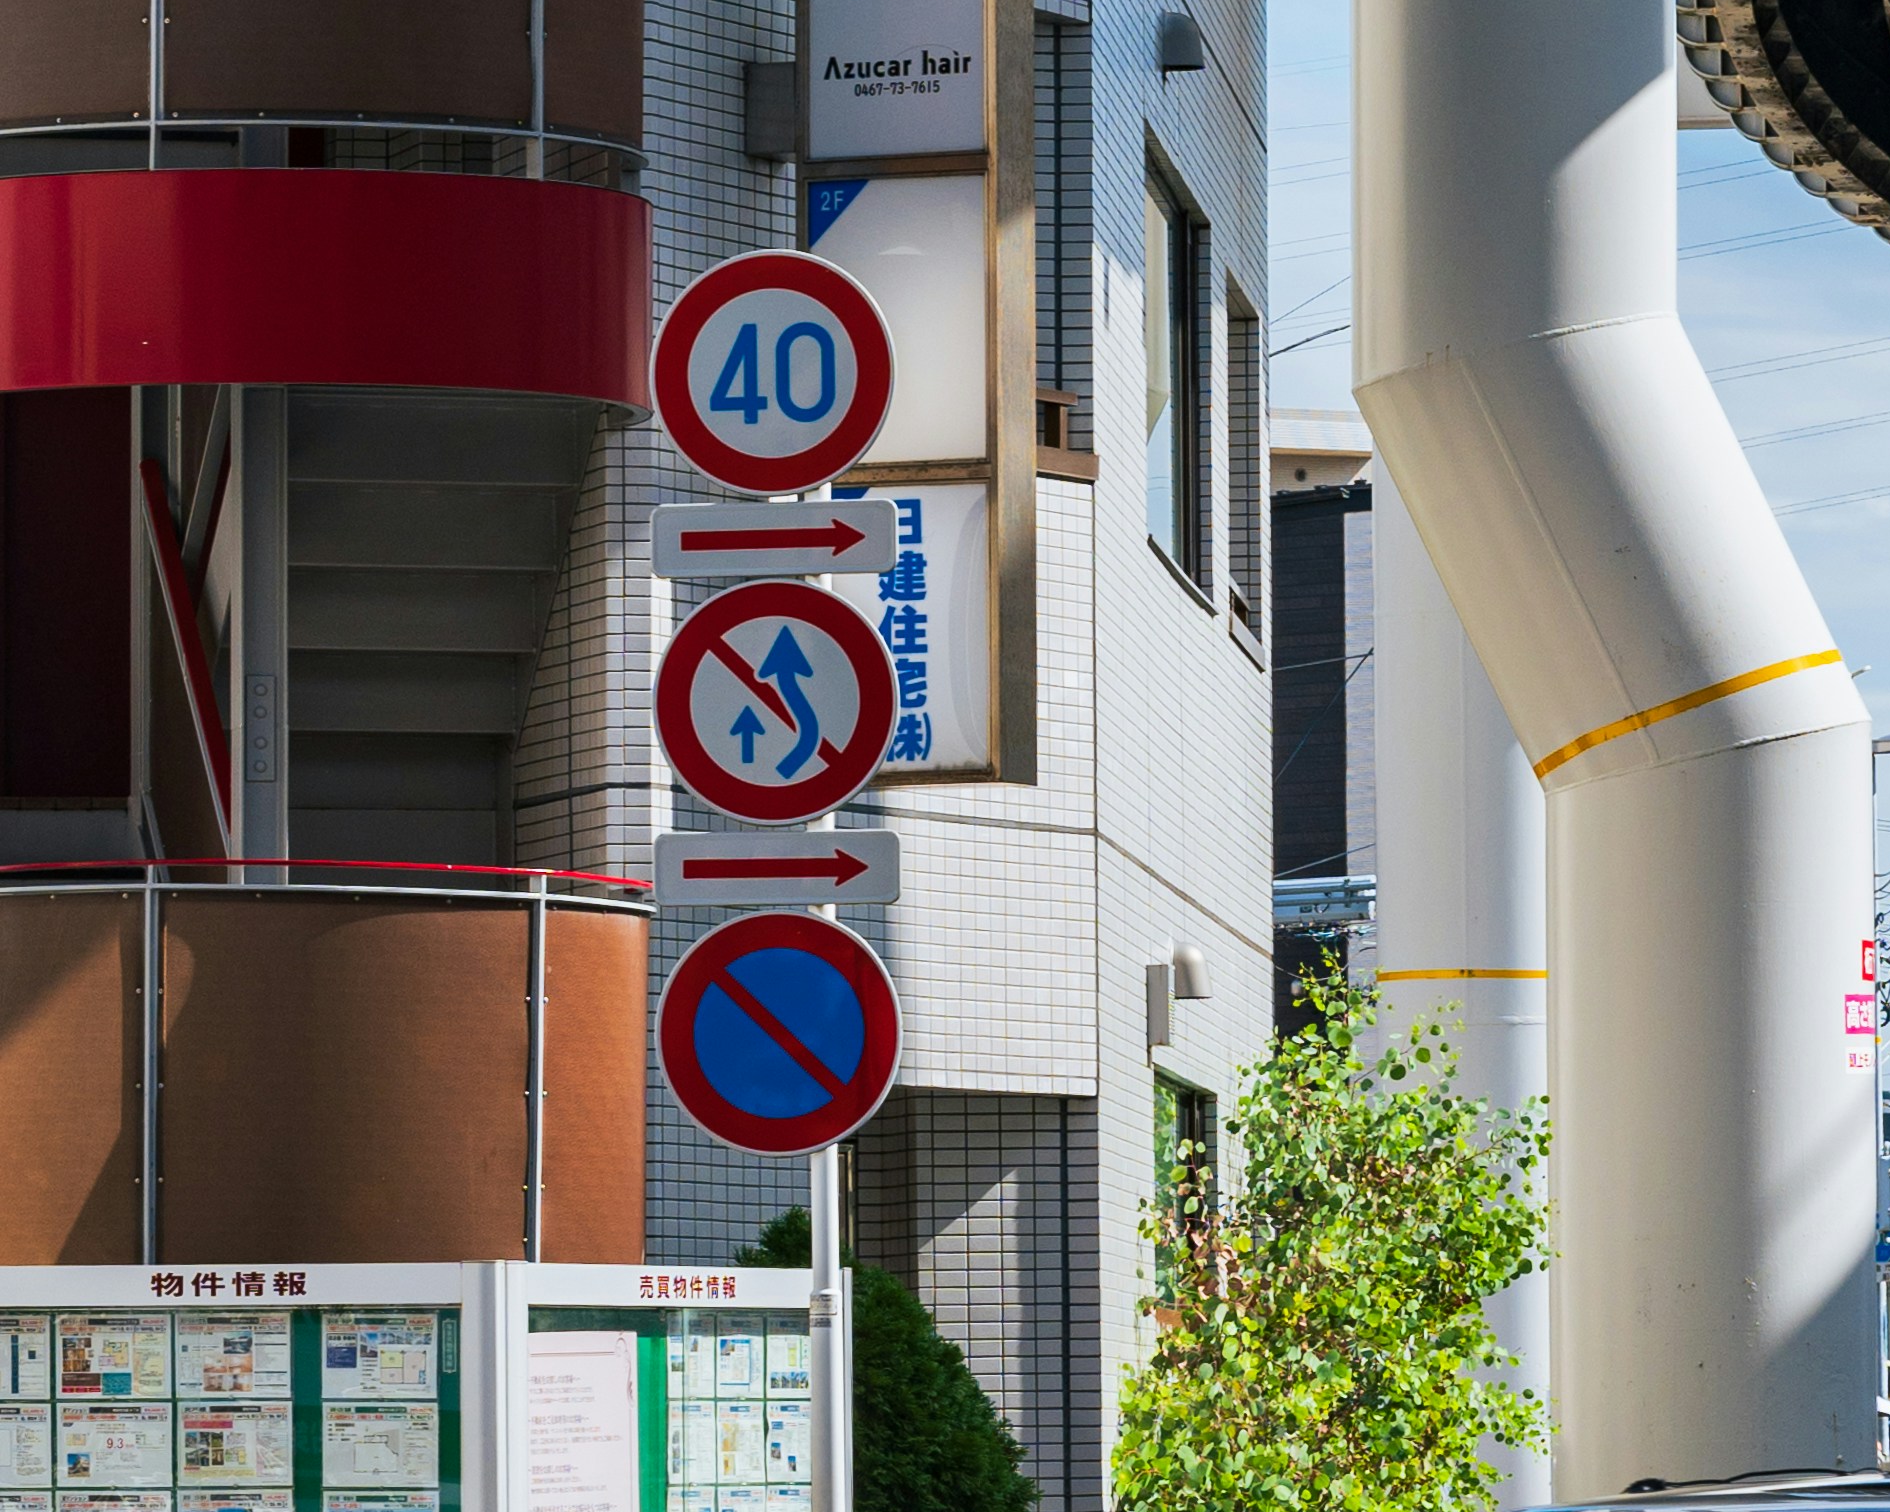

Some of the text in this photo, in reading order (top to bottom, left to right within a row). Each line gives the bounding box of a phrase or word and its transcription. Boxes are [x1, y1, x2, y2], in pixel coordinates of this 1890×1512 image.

[823, 49, 972, 79] Azucar hair
[854, 80, 941, 96] 0467-73-7615
[820, 190, 845, 212] 2F
[709, 321, 837, 425] 40
[151, 1272, 308, 1298] 物件情報
[639, 1275, 737, 1299] 売買物件情報
[106, 1437, 124, 1449] 9.3
